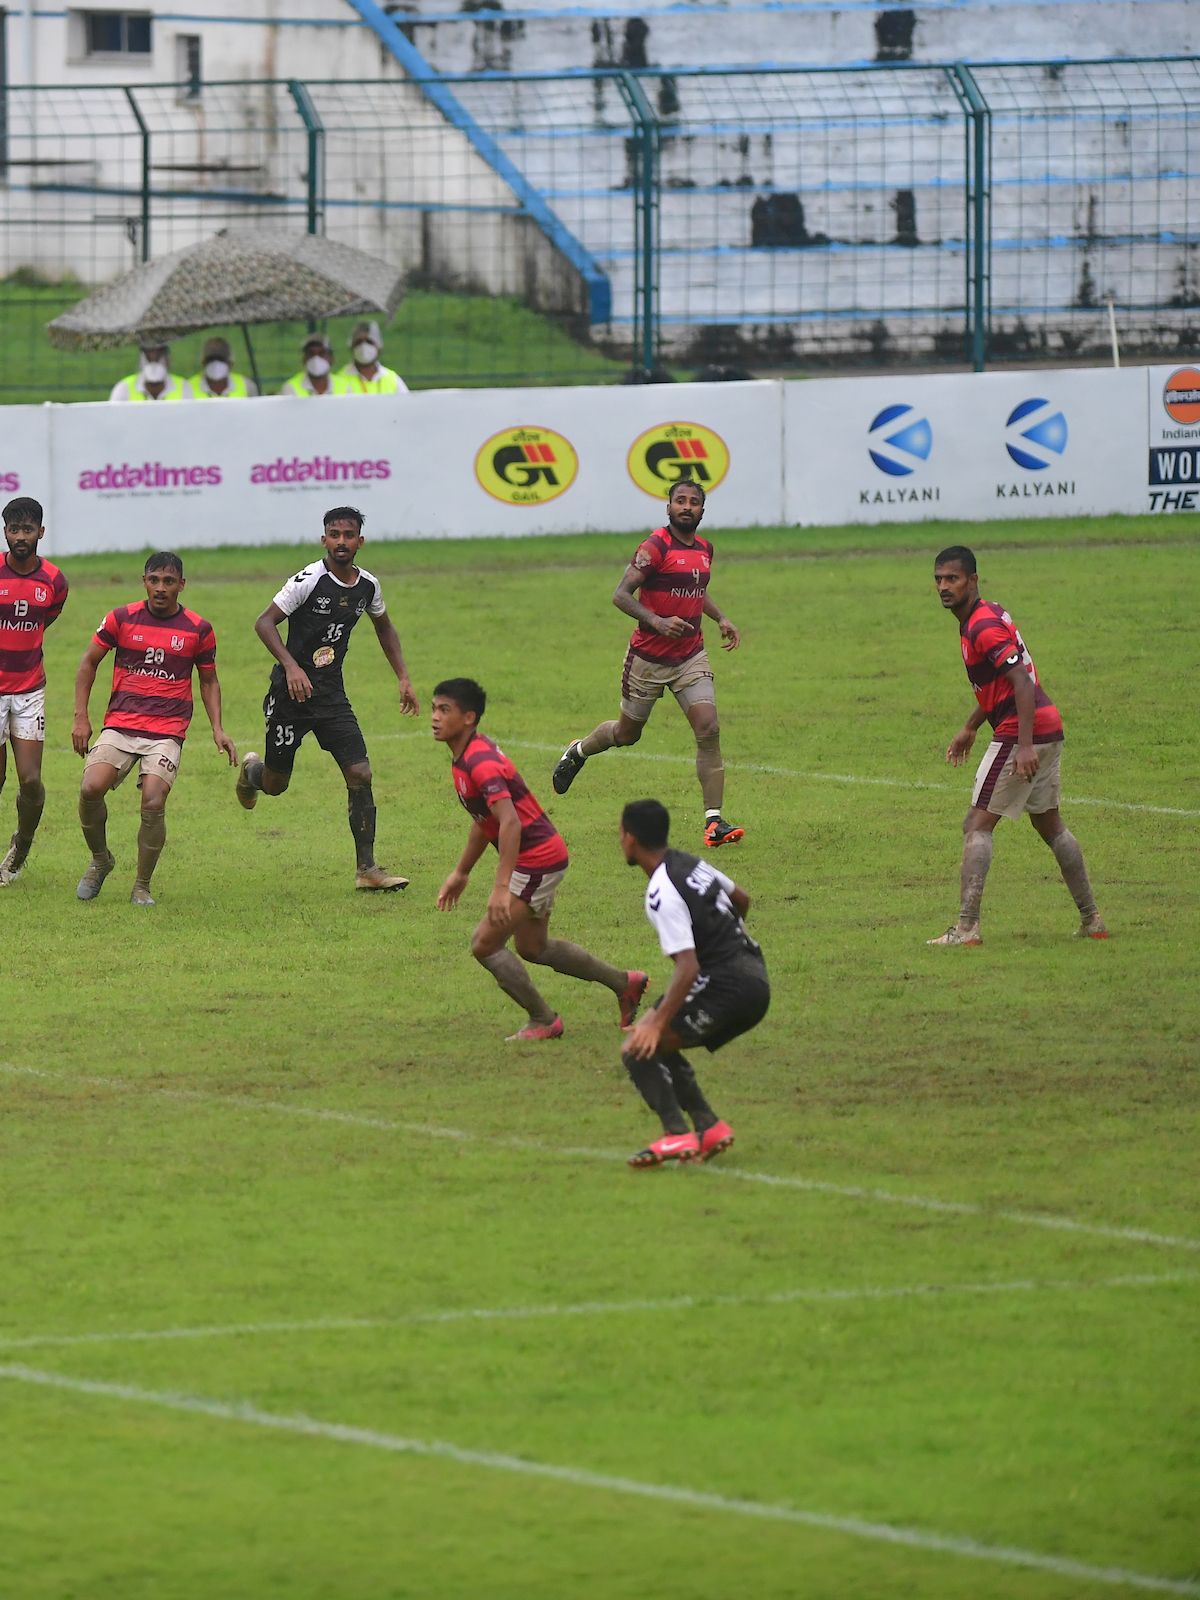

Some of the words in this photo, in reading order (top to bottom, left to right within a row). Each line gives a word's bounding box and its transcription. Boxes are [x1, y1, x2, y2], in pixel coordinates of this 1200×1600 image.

[251, 456, 391, 483] addatimes
[1157, 451, 1200, 481] WO
[79, 462, 222, 490] addatimes
[511, 491, 540, 500] GAIL
[859, 486, 941, 504] KALYANI
[996, 481, 1076, 498] KALYANI
[1149, 490, 1199, 510] THE
[691, 568, 700, 585] 4
[13, 600, 29, 617] 13
[321, 623, 345, 643] 35
[144, 647, 165, 665] 20
[274, 724, 295, 746] 35
